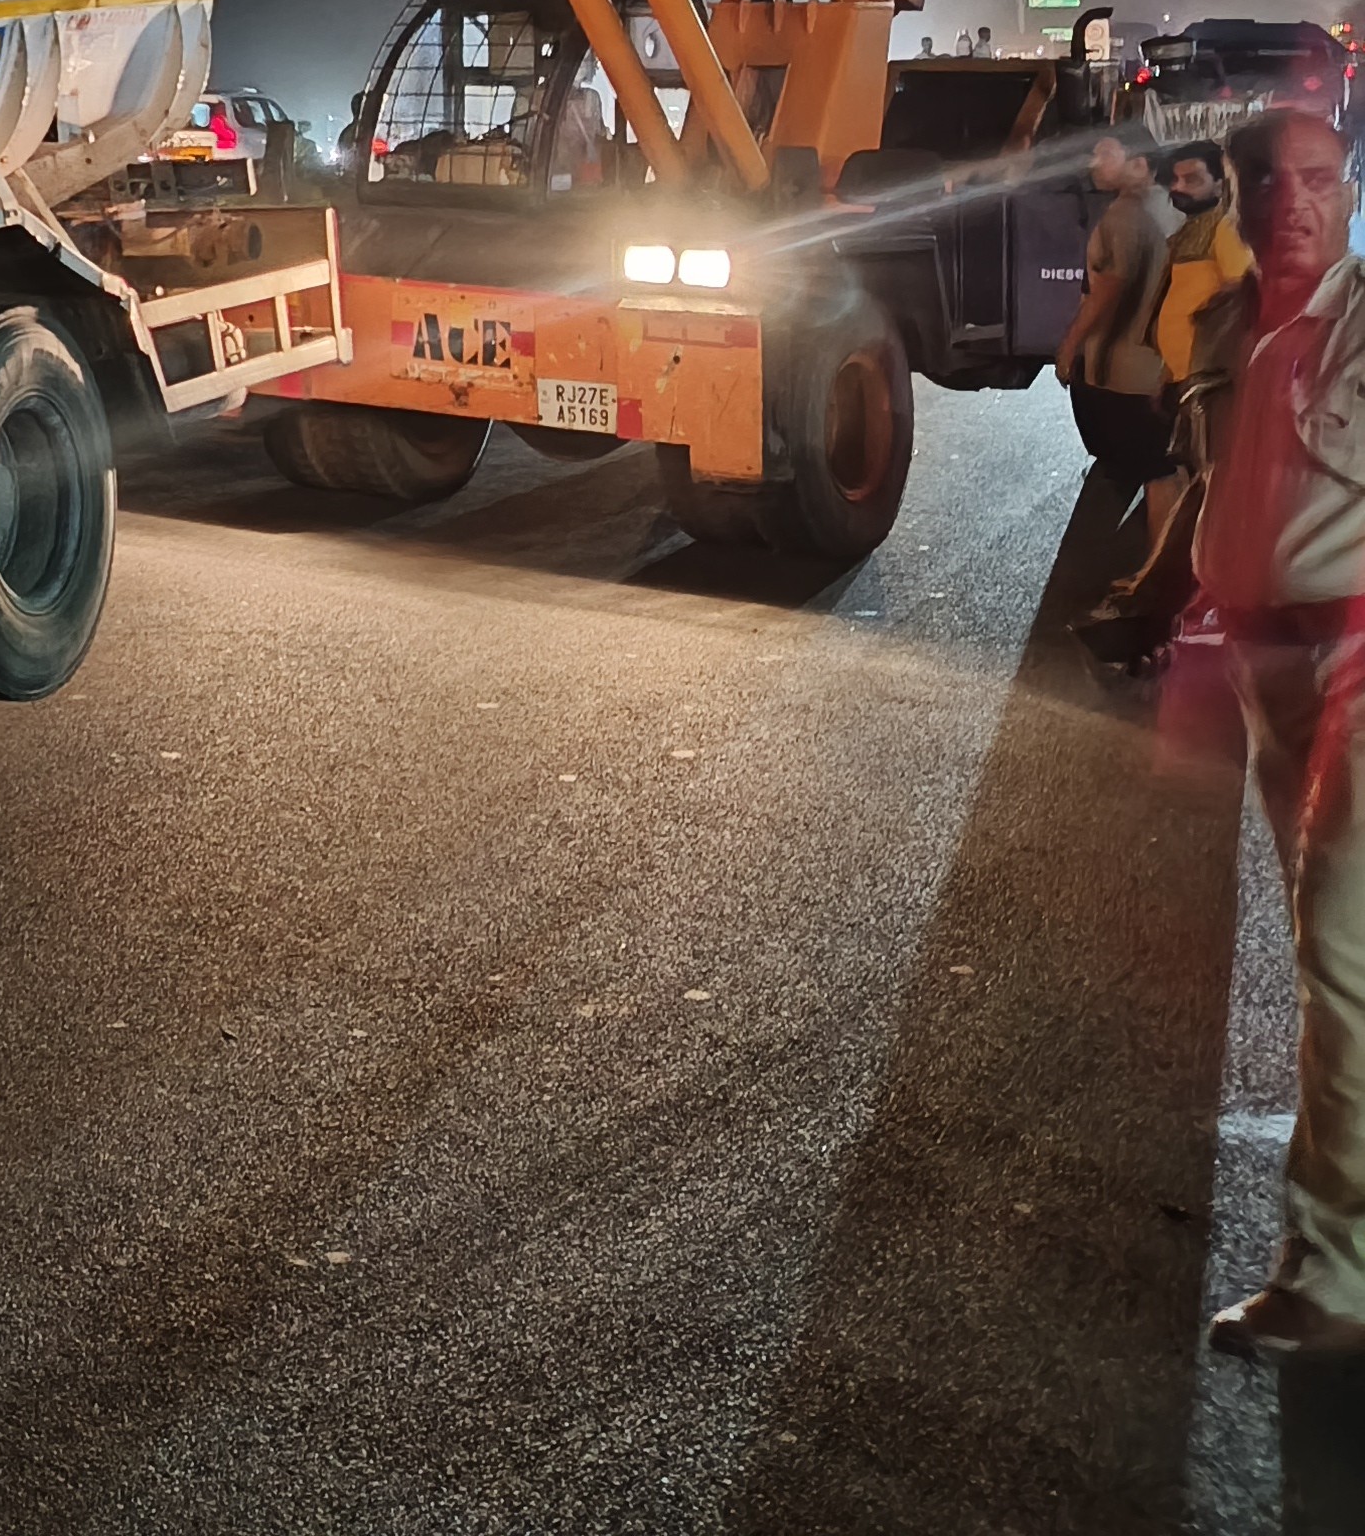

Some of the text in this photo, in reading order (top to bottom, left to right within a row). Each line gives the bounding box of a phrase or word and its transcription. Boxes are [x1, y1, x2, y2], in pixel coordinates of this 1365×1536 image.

[1040, 268, 1084, 280] DIESE
[413, 313, 511, 369] ACE
[556, 384, 609, 406] RJ27E
[557, 407, 609, 427] A5169
